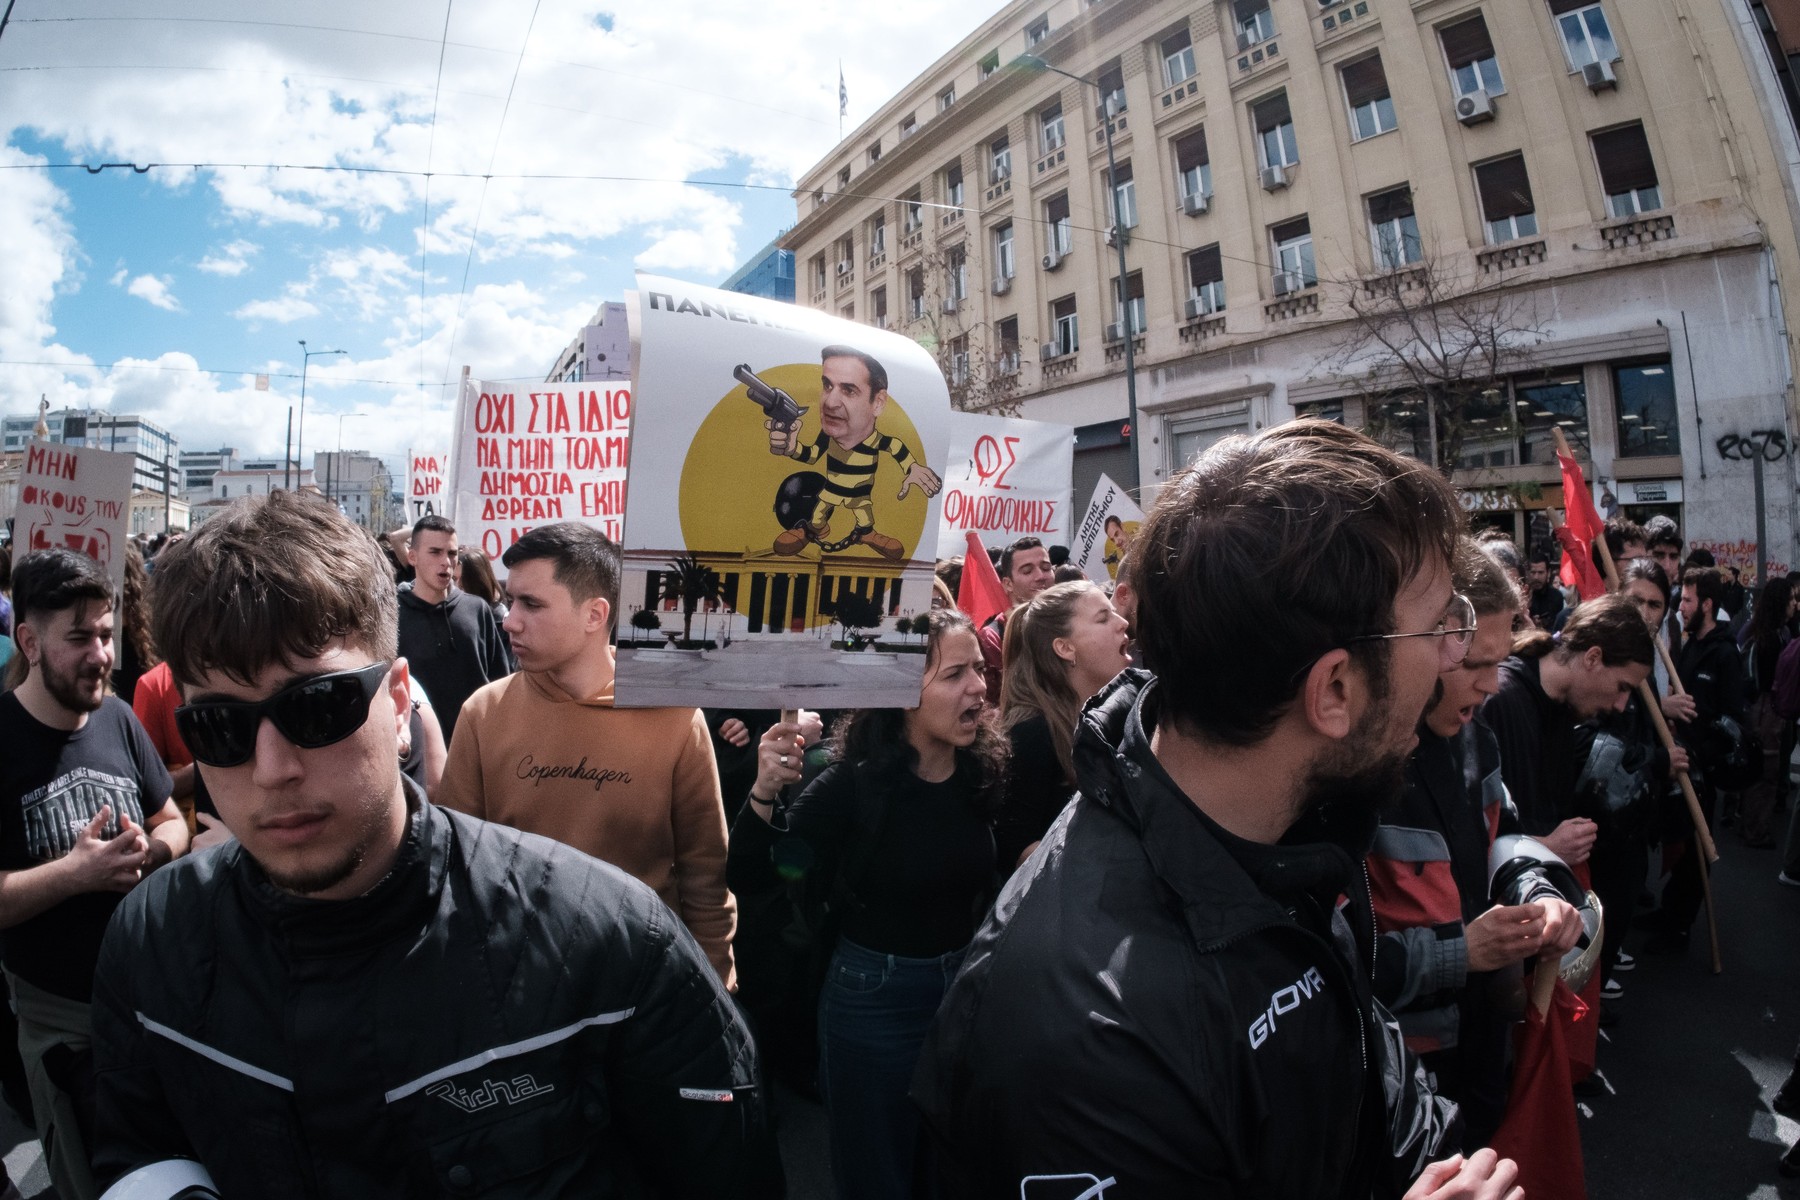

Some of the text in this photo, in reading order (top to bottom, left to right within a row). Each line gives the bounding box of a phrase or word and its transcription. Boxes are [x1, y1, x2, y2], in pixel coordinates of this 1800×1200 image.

[475, 393, 514, 433] ΟΧΙ
[527, 392, 570, 433] ΣΤΑ
[26, 445, 77, 481] ΜΗΝ
[413, 456, 438, 473] ΝΑ
[477, 437, 501, 469] ΝΑ
[507, 437, 554, 470] ΜΗΝ
[480, 471, 574, 496] ΔΗΜΟΣΙΑ
[481, 497, 562, 520] ΔΩΡΕΑΝ
[944, 489, 1059, 535] ΦΙΛΟΣΟΦΙΚΗΣ
[1078, 486, 1116, 569] ΠΑΝΕΠΙΣΤΗΜΙΟΥ
[516, 754, 632, 791] Copenhagen
[425, 1073, 554, 1113] Richa
